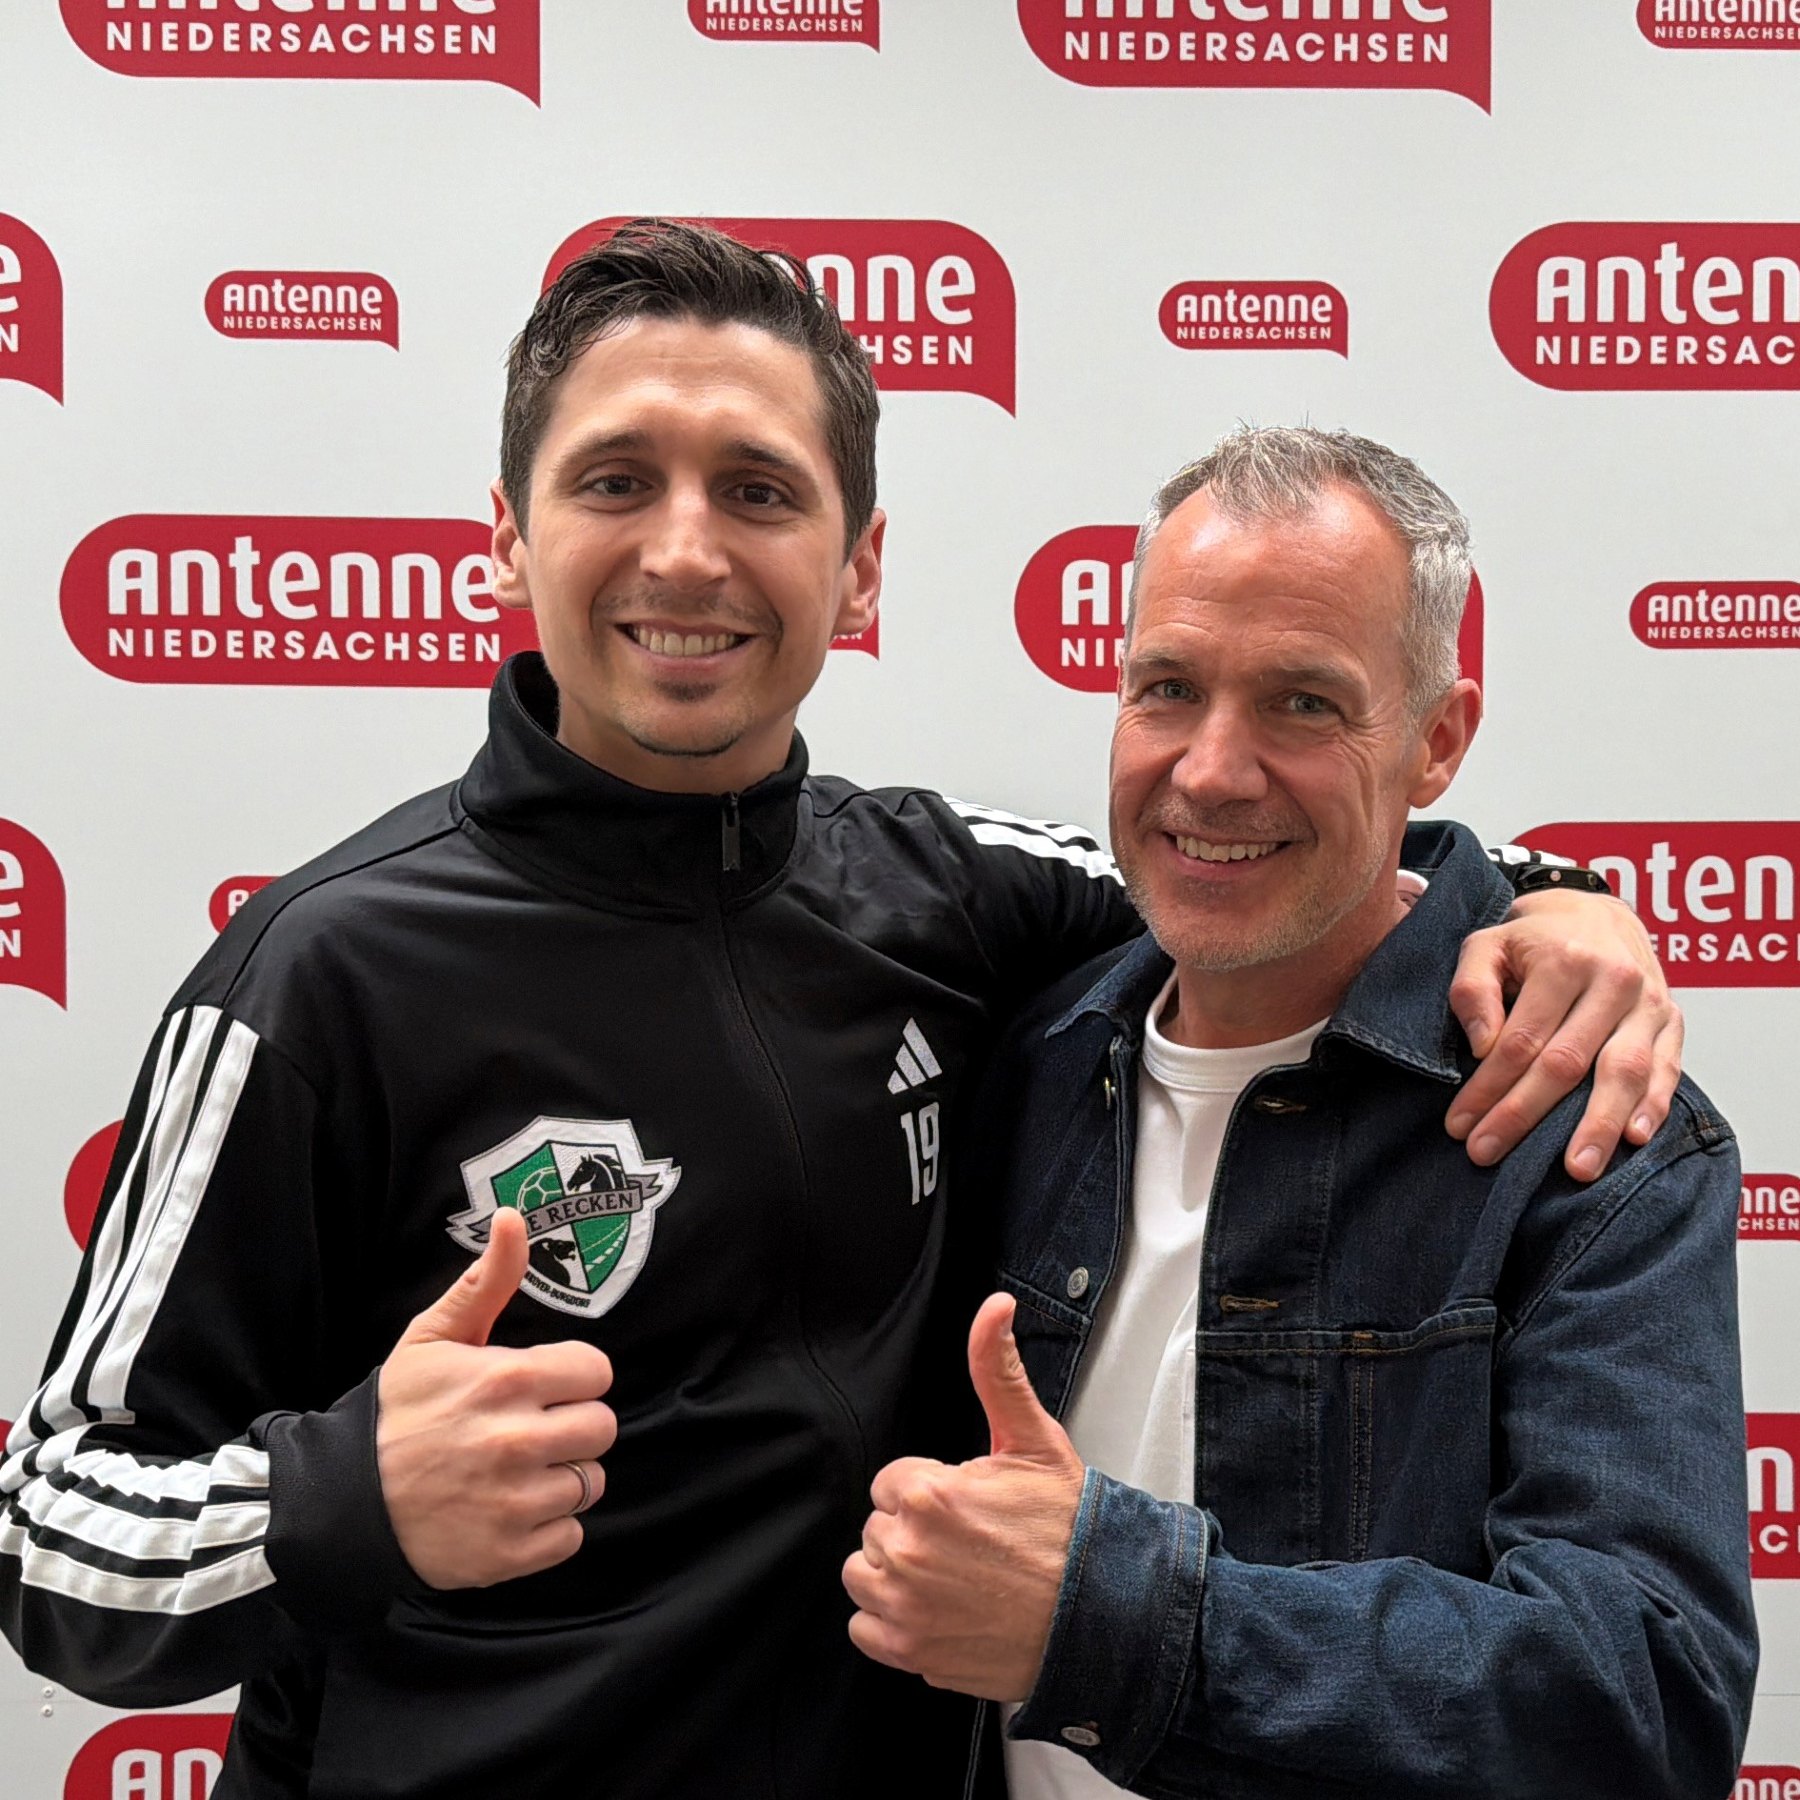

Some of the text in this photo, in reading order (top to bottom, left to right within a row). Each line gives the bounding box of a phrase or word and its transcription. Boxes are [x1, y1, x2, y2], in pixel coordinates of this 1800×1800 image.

[106, 22, 496, 54] NIEDERSACHSEN
[706, 17, 863, 32] NIEDERSACHSEN
[1655, 26, 1800, 40] NIEDERSACHSE
[1065, 31, 1448, 62] NIEDERSACHSEN
[223, 316, 382, 331] NIEDERSACHSEN
[1176, 326, 1331, 340] NIEDERSACHSEN
[1536, 335, 1795, 365] NIEDERSAC
[108, 629, 500, 662] NIEDERSACHSEN
[1647, 626, 1800, 640] NIEDERSACHSEN
[900, 1101, 940, 1206] 19
[546, 1191, 634, 1224] RECKEN
